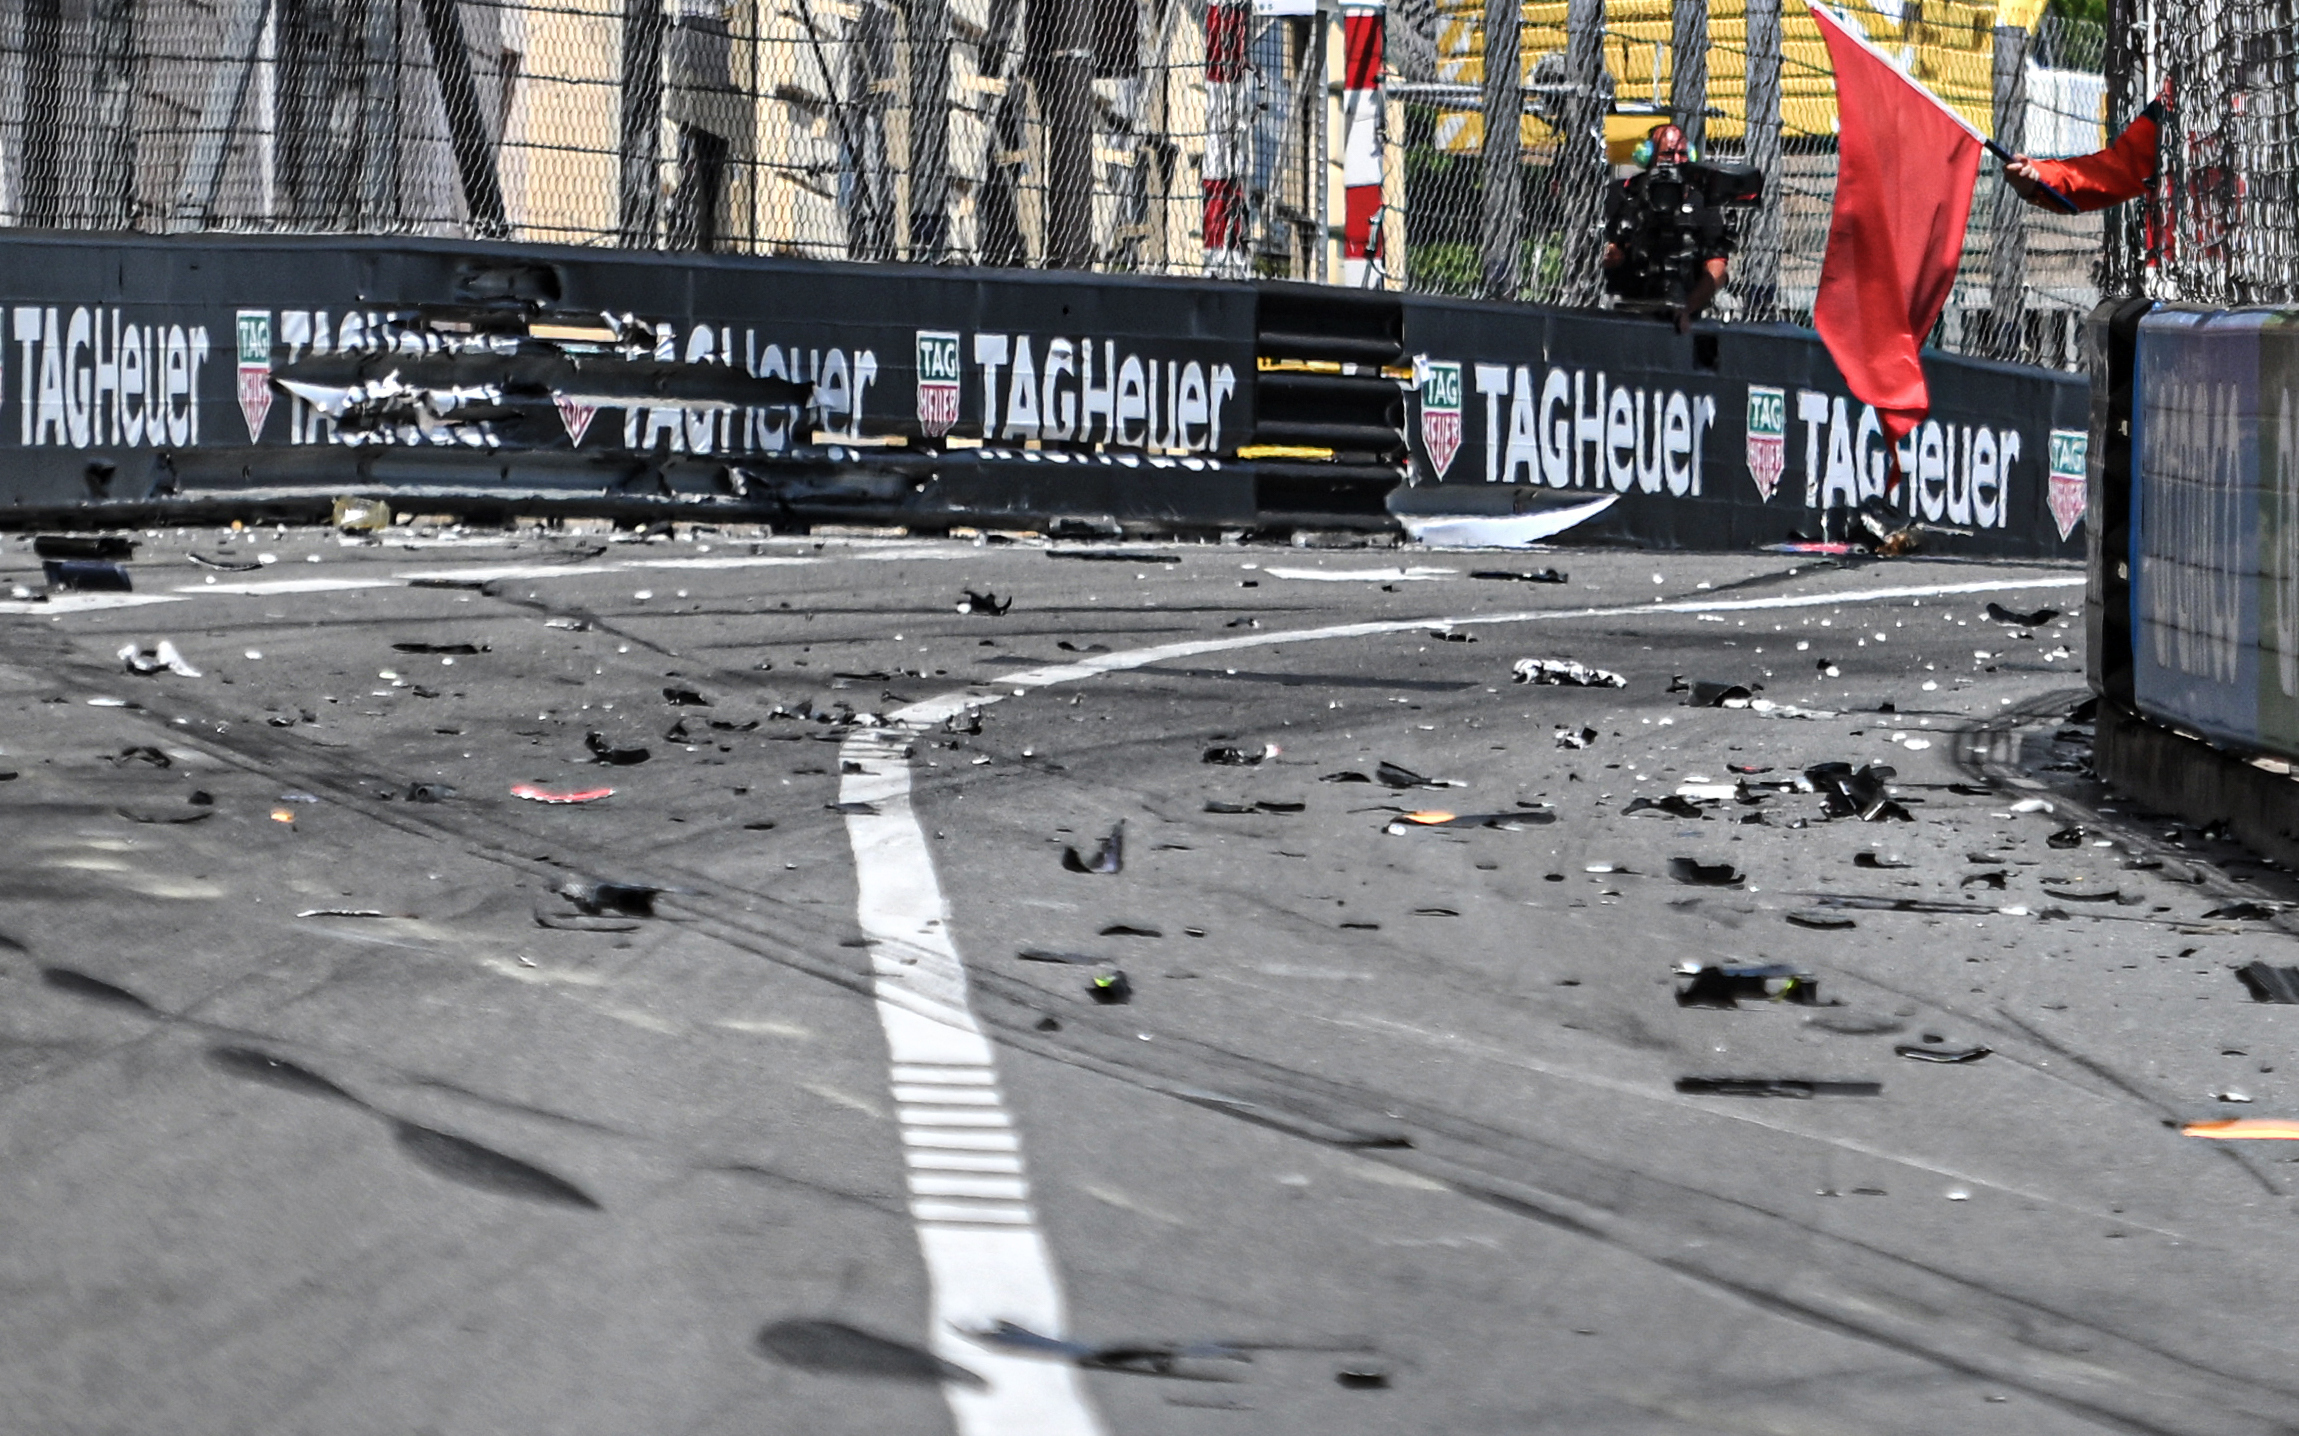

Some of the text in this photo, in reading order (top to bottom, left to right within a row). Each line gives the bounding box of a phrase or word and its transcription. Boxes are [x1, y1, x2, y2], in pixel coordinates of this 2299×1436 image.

[238, 321, 268, 358] TAG
[920, 341, 956, 378] TAG
[1427, 371, 1457, 406] TAG
[1475, 364, 1716, 497] TAGHeuer
[1751, 396, 1781, 431] TAG
